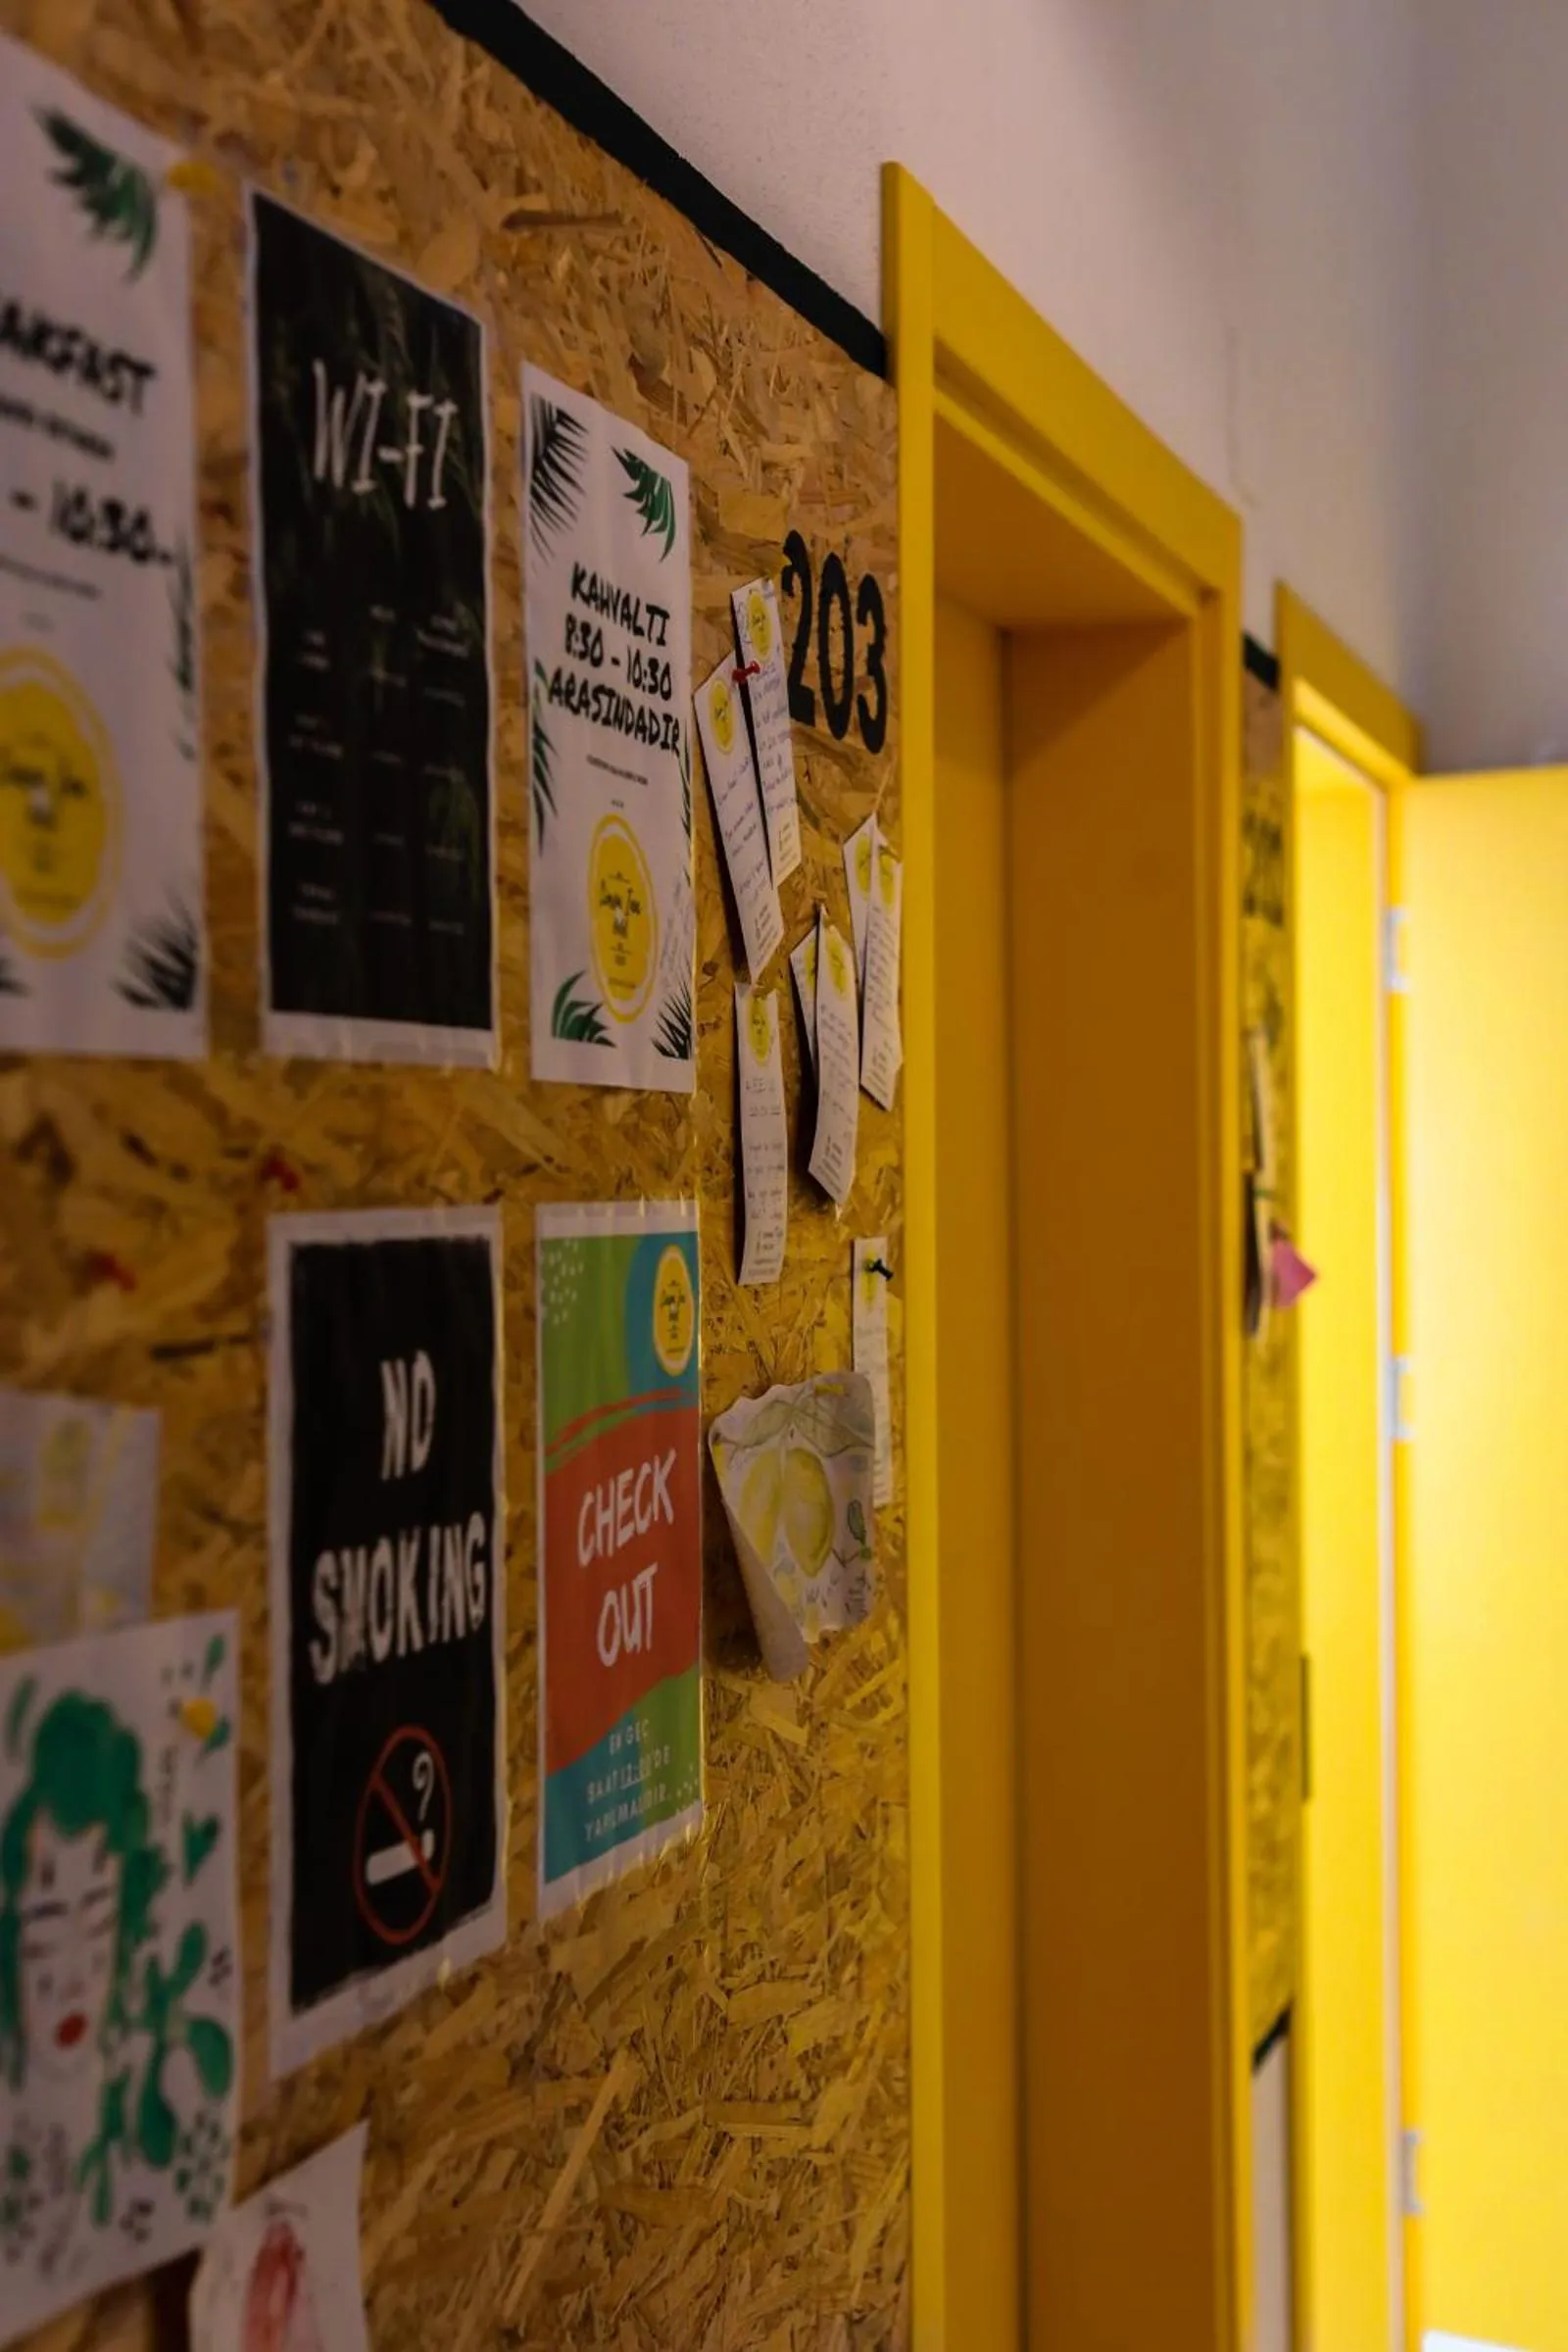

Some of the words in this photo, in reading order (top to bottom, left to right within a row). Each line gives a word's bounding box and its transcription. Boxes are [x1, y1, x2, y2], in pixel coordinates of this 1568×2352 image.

[313, 359, 459, 511] WI-FI
[564, 612, 604, 668] 8:30
[626, 645, 672, 701] 10:30
[570, 562, 670, 647] KAHVALTI
[781, 529, 888, 755] 203
[550, 667, 680, 757] ARASINDADIR
[381, 1350, 436, 1480] NO
[578, 1447, 677, 1566] CHECK
[310, 1512, 487, 1685] SMOKING
[597, 1562, 659, 1667] OUT
